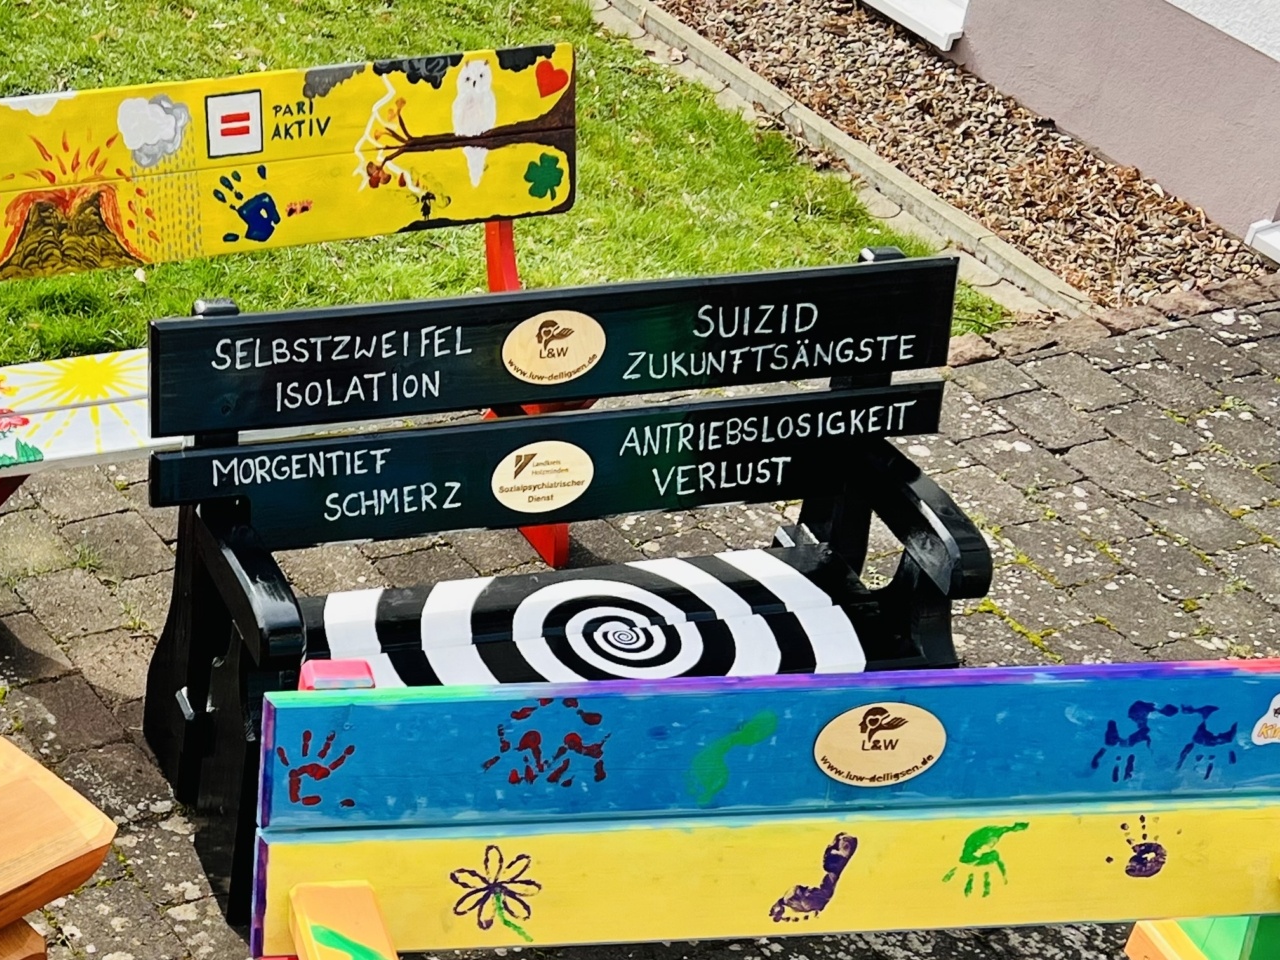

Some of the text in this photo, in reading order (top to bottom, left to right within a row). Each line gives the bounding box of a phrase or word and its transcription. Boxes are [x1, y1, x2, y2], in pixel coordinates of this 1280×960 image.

[272, 99, 314, 118] PARI
[271, 116, 331, 141] AKTIV
[693, 303, 818, 338] SUIZID
[211, 325, 473, 371] SELBSTZWEIFEL
[539, 347, 569, 359] L&W
[622, 334, 917, 380] ZUKUNFTSÄNGSTE
[507, 353, 598, 381] www.luw-delligsen.de
[276, 370, 440, 412] ISOLATION
[619, 400, 917, 457] ANTRIEBSLOSIGKEIT
[212, 448, 392, 487] MORGENTIEF
[652, 456, 792, 496] VERLUST
[323, 481, 462, 521] SCHMERZ
[499, 479, 586, 493] Sozialpsychiatrischer
[527, 494, 554, 504] Dienst
[861, 739, 899, 751] L&W
[820, 754, 934, 783] www.luw-delligsen.de
